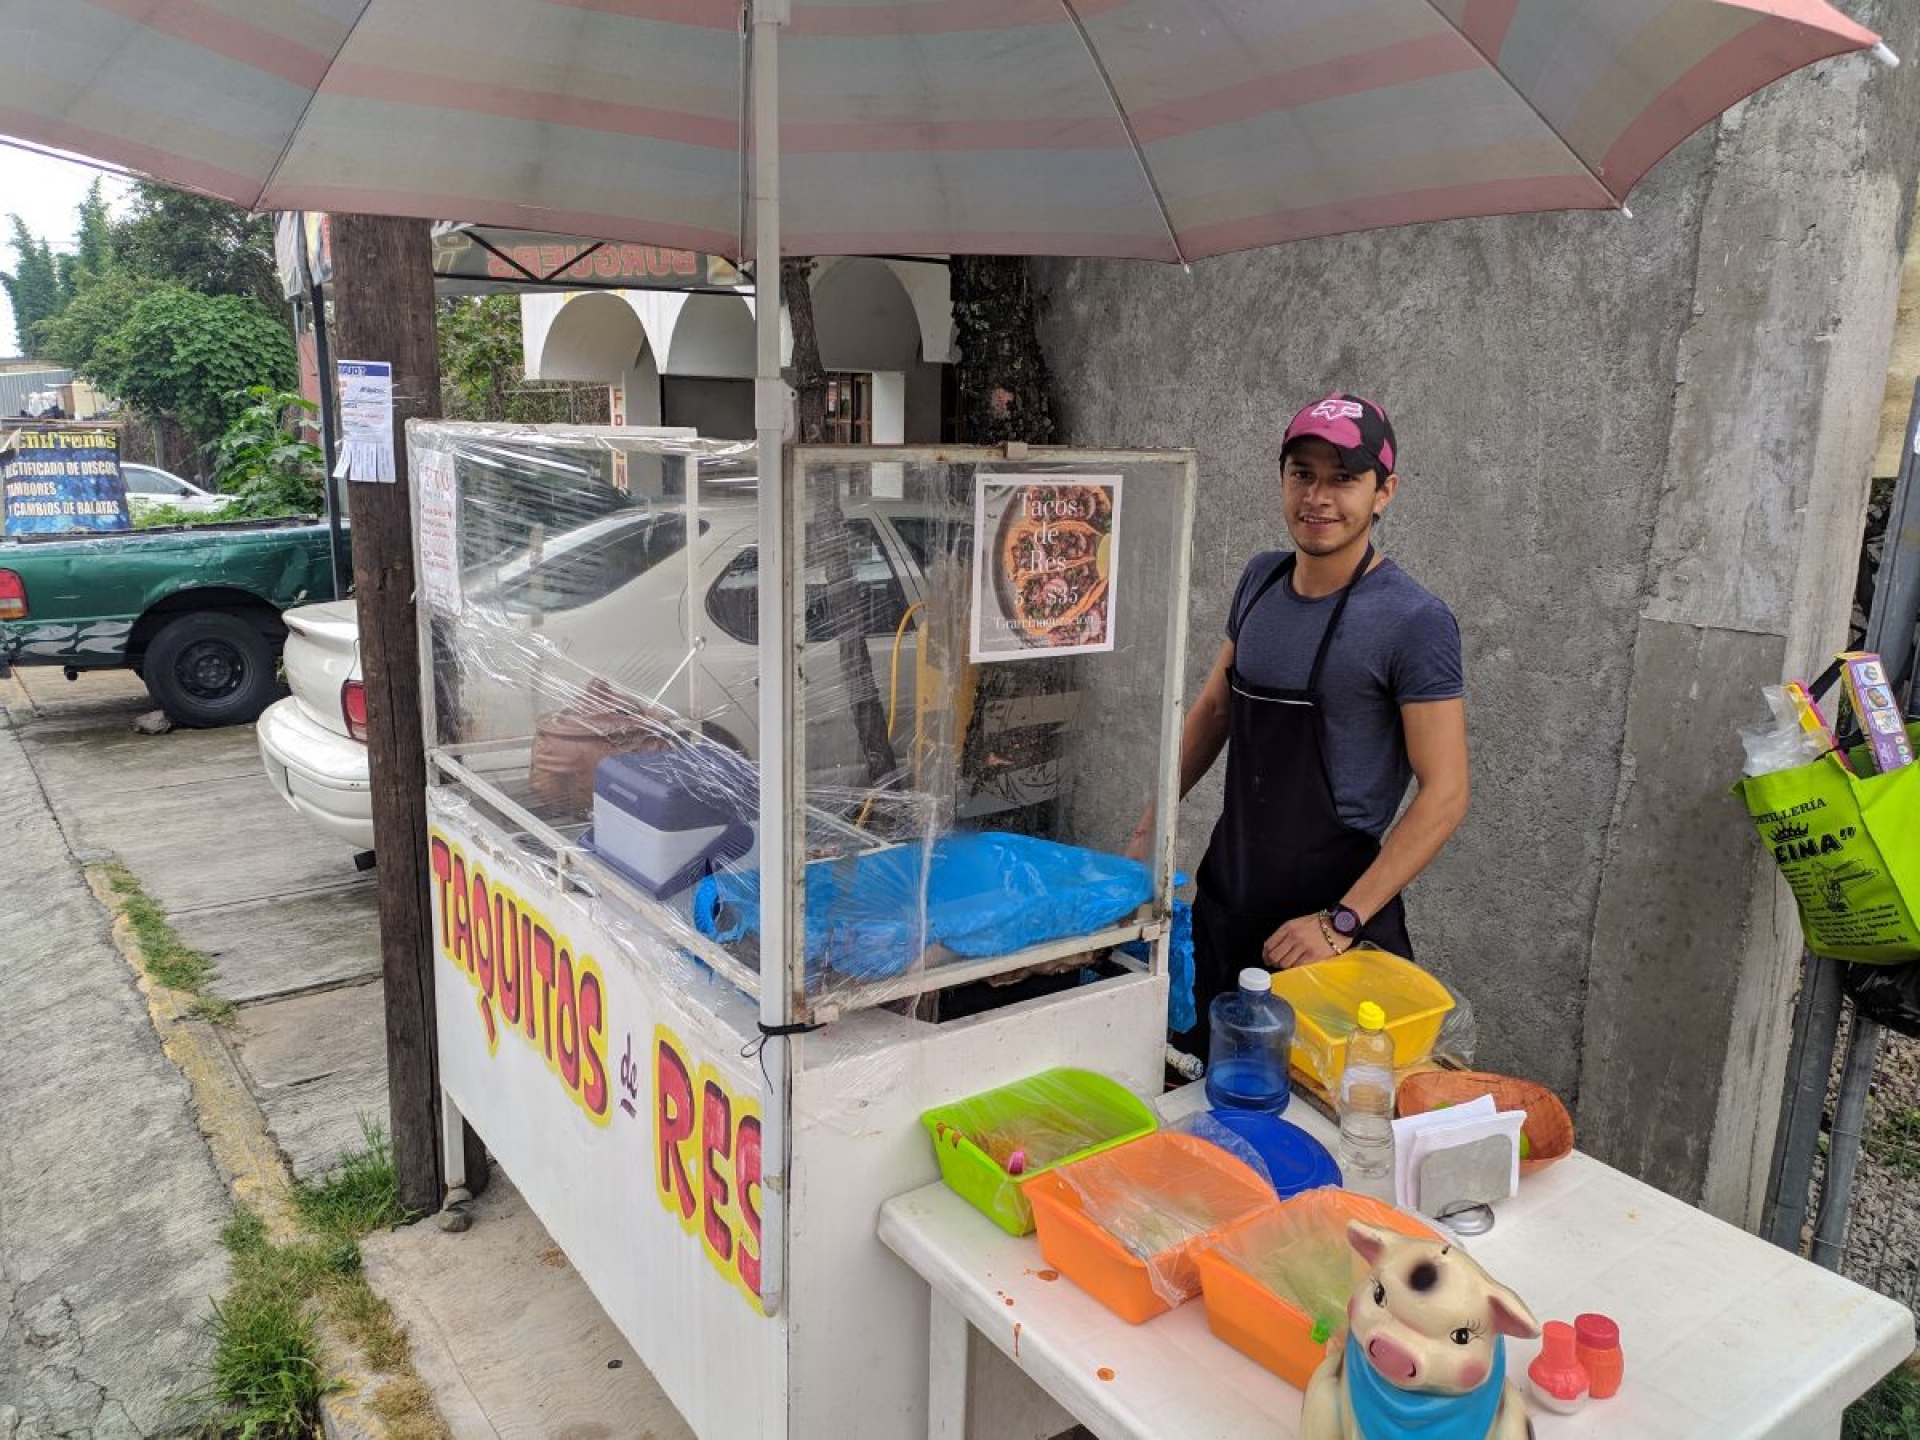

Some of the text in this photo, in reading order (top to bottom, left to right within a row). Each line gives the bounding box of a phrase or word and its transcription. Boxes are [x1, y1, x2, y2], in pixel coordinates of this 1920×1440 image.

[66, 462, 79, 475] DE
[13, 501, 60, 516] CAMBIOS
[62, 502, 75, 515] DE
[76, 501, 119, 515] BALATAS
[1017, 492, 1078, 516] Tacos
[1034, 522, 1059, 544] de
[1031, 550, 1067, 572] Res
[432, 836, 609, 1116] TAQUITOS
[620, 1032, 638, 1100] de
